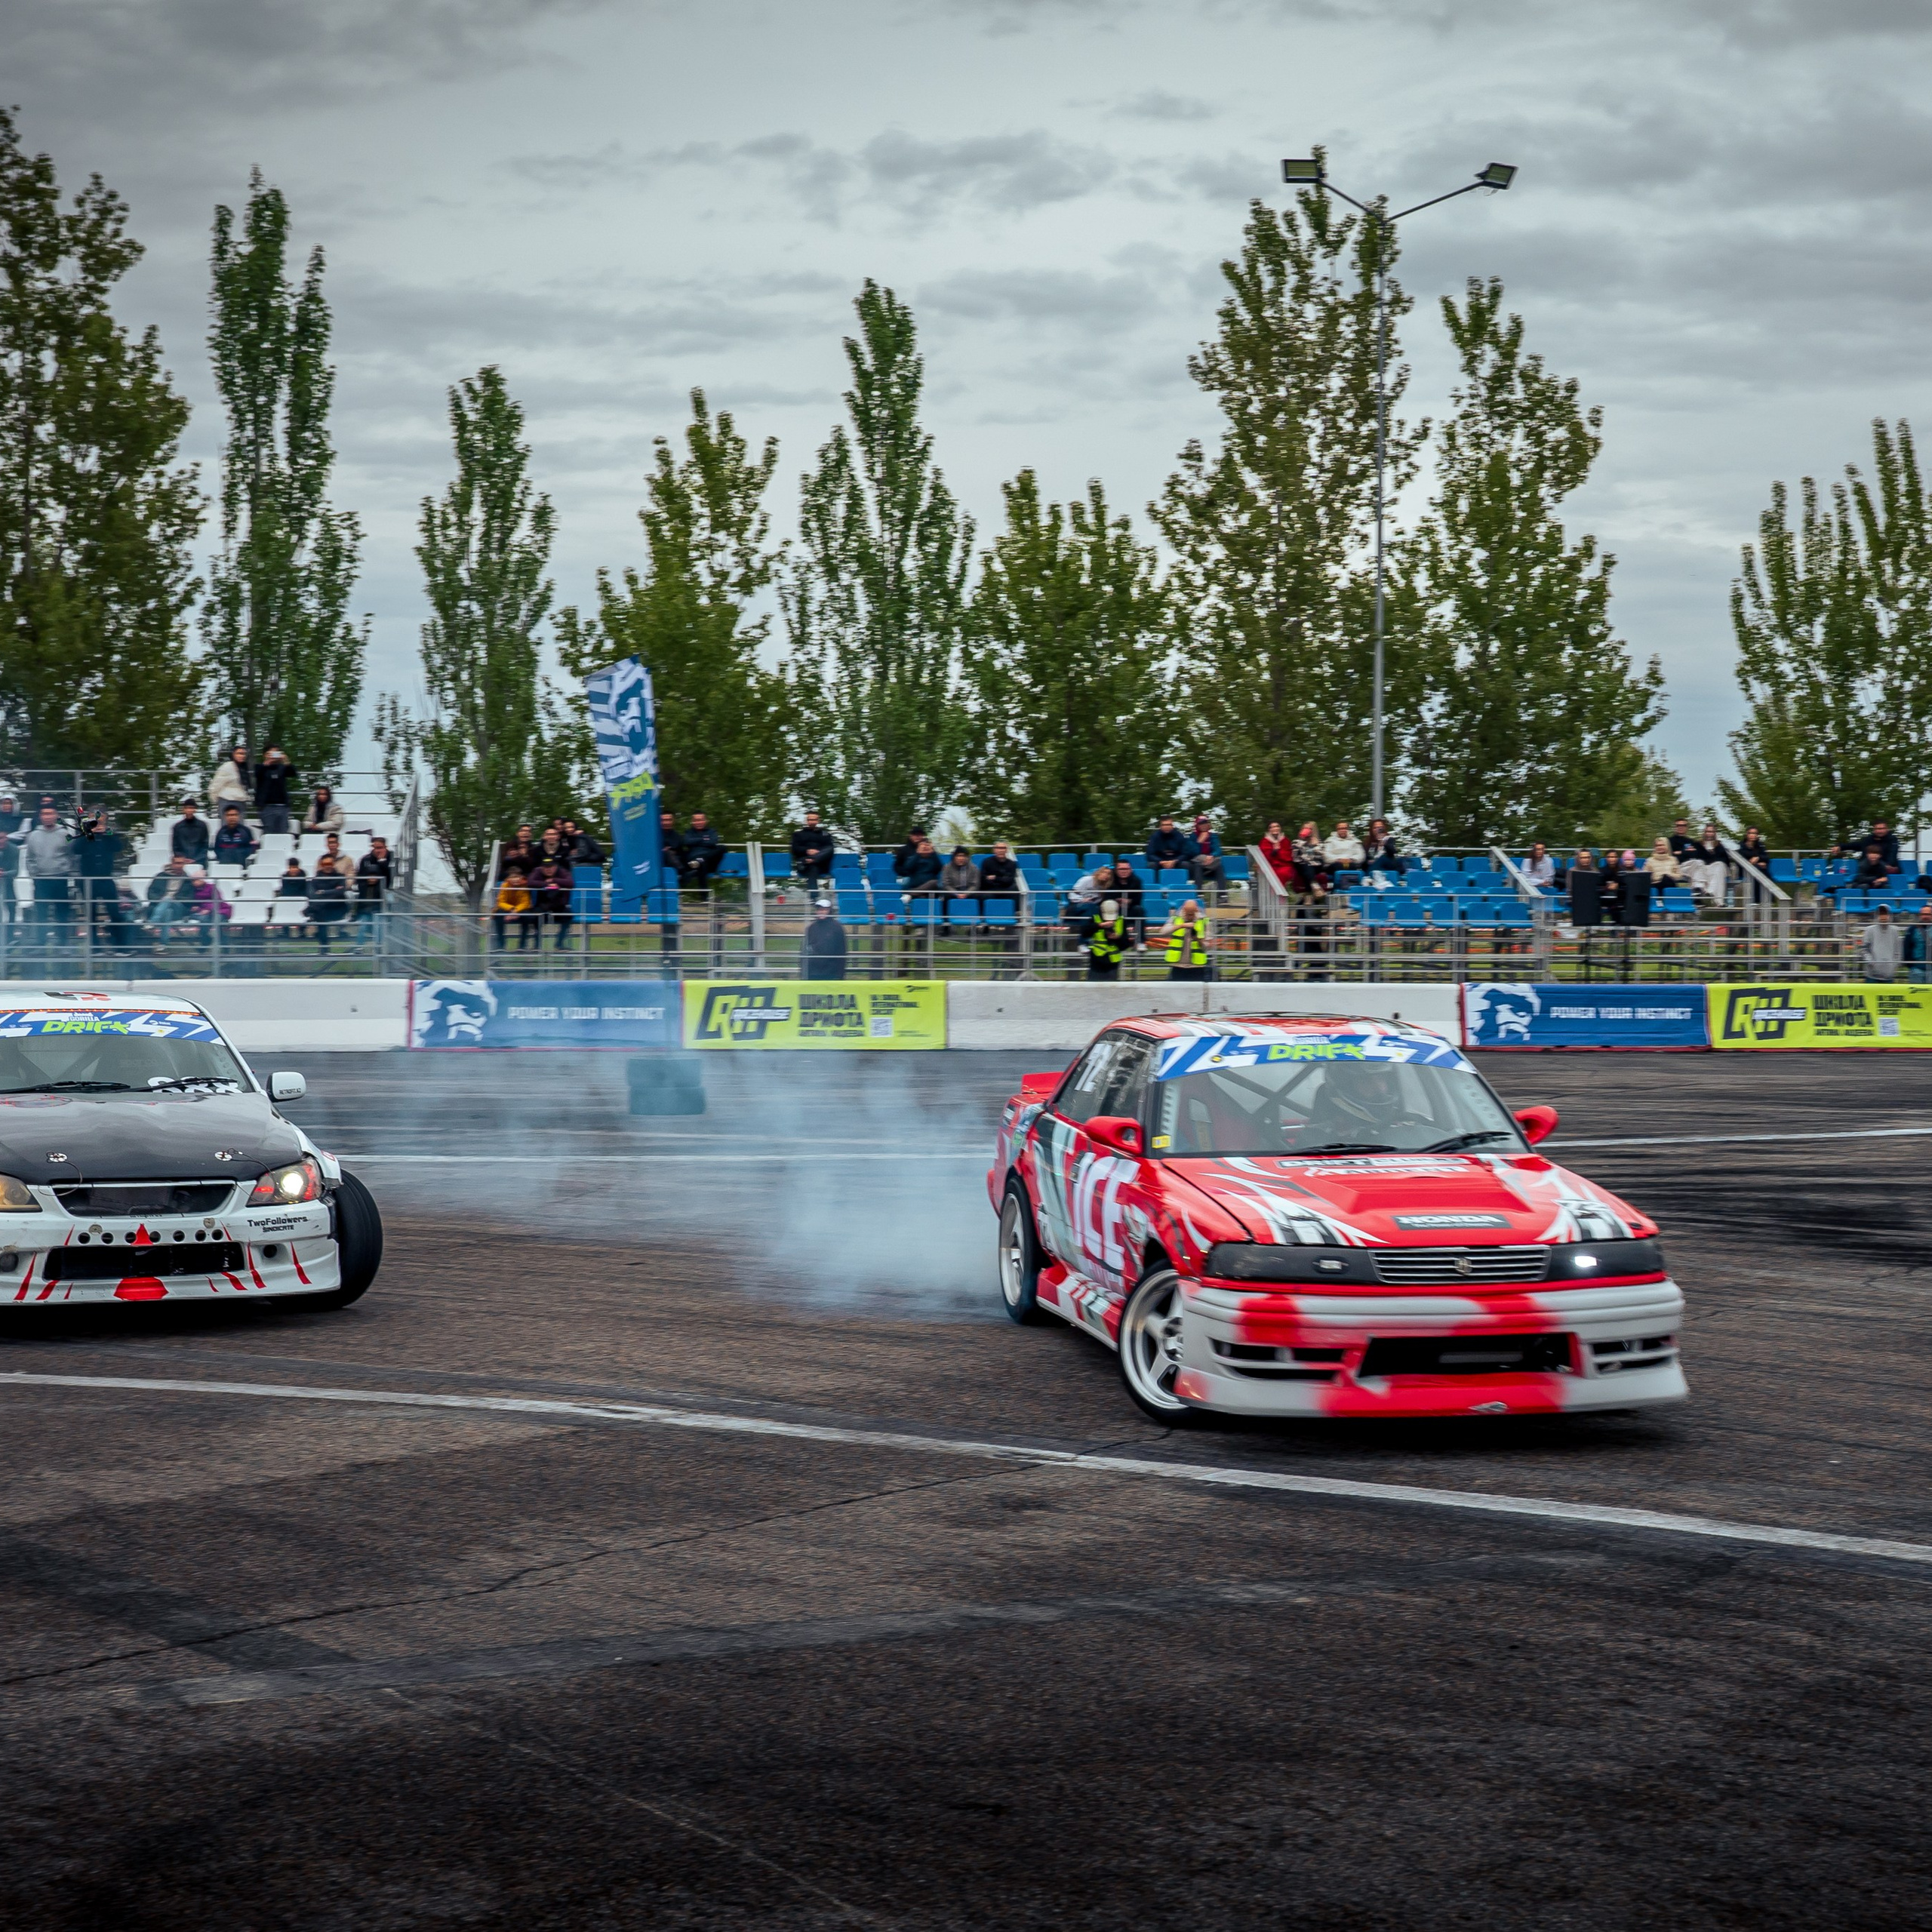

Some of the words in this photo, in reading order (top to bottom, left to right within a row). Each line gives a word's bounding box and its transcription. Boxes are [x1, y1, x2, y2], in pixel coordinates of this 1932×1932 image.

[1550, 1008, 1596, 1018] POWER
[1598, 1008, 1633, 1019] YOUR
[1635, 1008, 1693, 1019] INSTINCT
[41, 1020, 129, 1035] DRIFT
[1267, 1043, 1366, 1060] DRIFT
[247, 1216, 308, 1227] TwoFollowers
